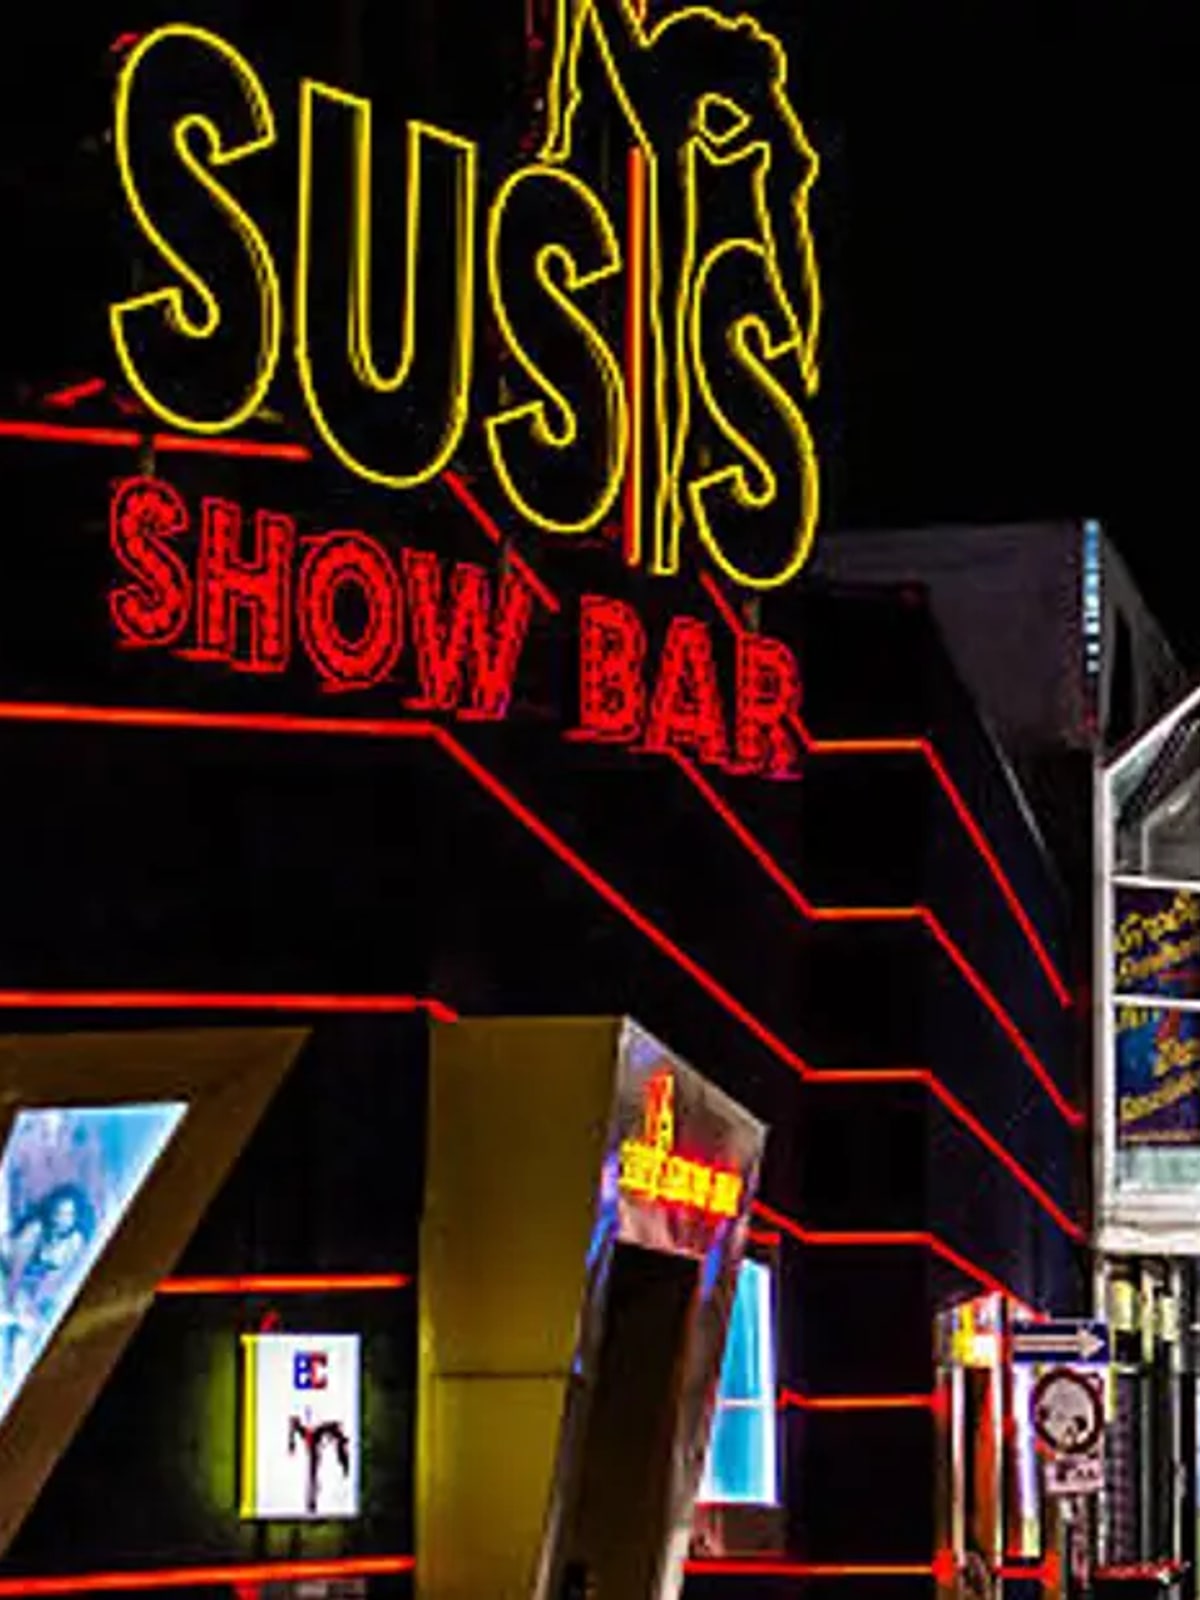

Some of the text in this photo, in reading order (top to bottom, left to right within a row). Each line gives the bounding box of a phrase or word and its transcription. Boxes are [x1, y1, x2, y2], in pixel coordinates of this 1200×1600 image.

[108, 475, 803, 779] SHOW BAR
[293, 1352, 329, 1390] EC
